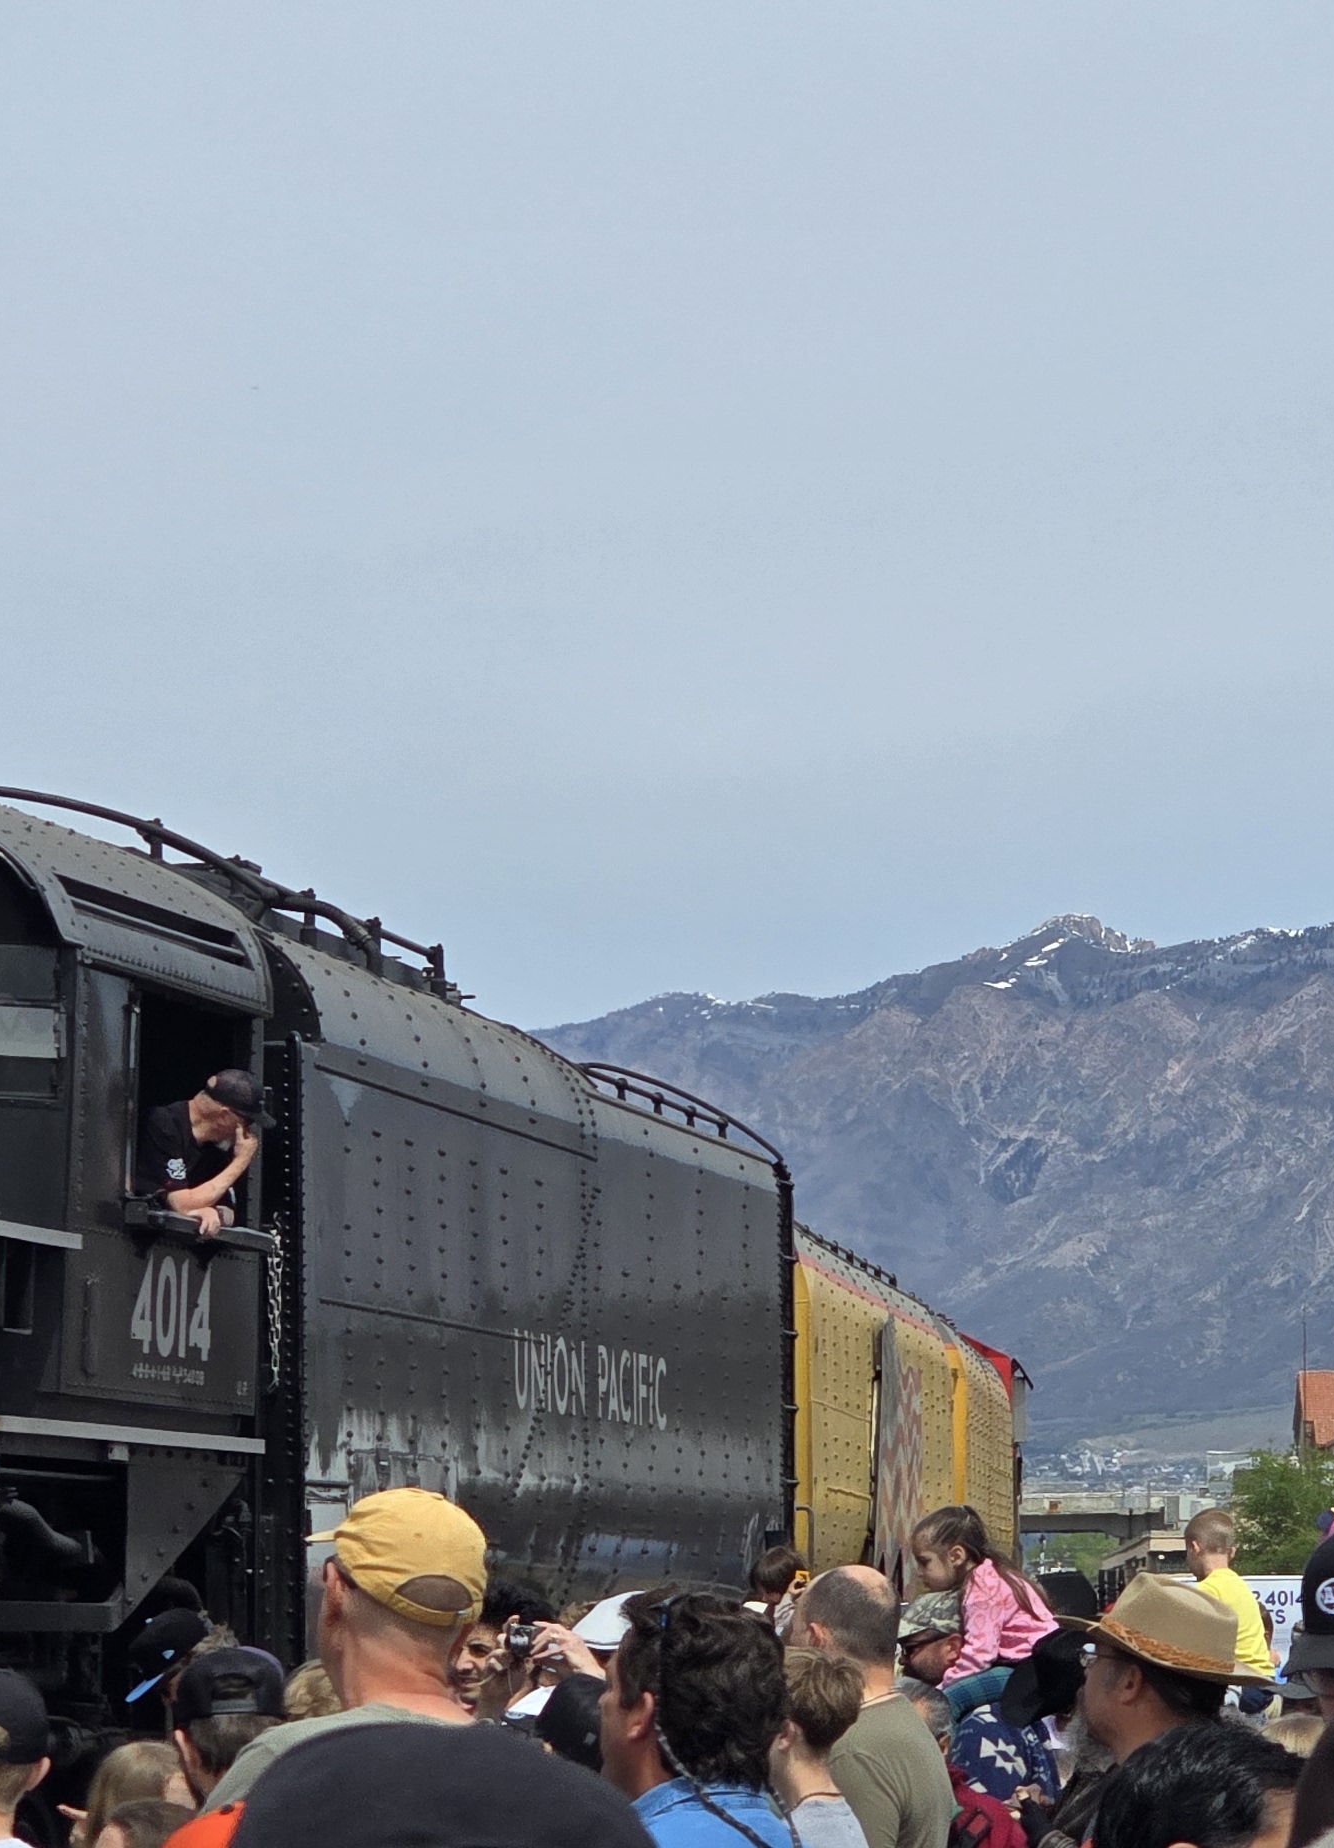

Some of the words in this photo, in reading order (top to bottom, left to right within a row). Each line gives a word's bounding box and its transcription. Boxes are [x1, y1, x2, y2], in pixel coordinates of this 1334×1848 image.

[130, 1252, 211, 1361] 4014
[514, 1328, 586, 1416] UNION
[598, 1345, 667, 1431] PACIFIC
